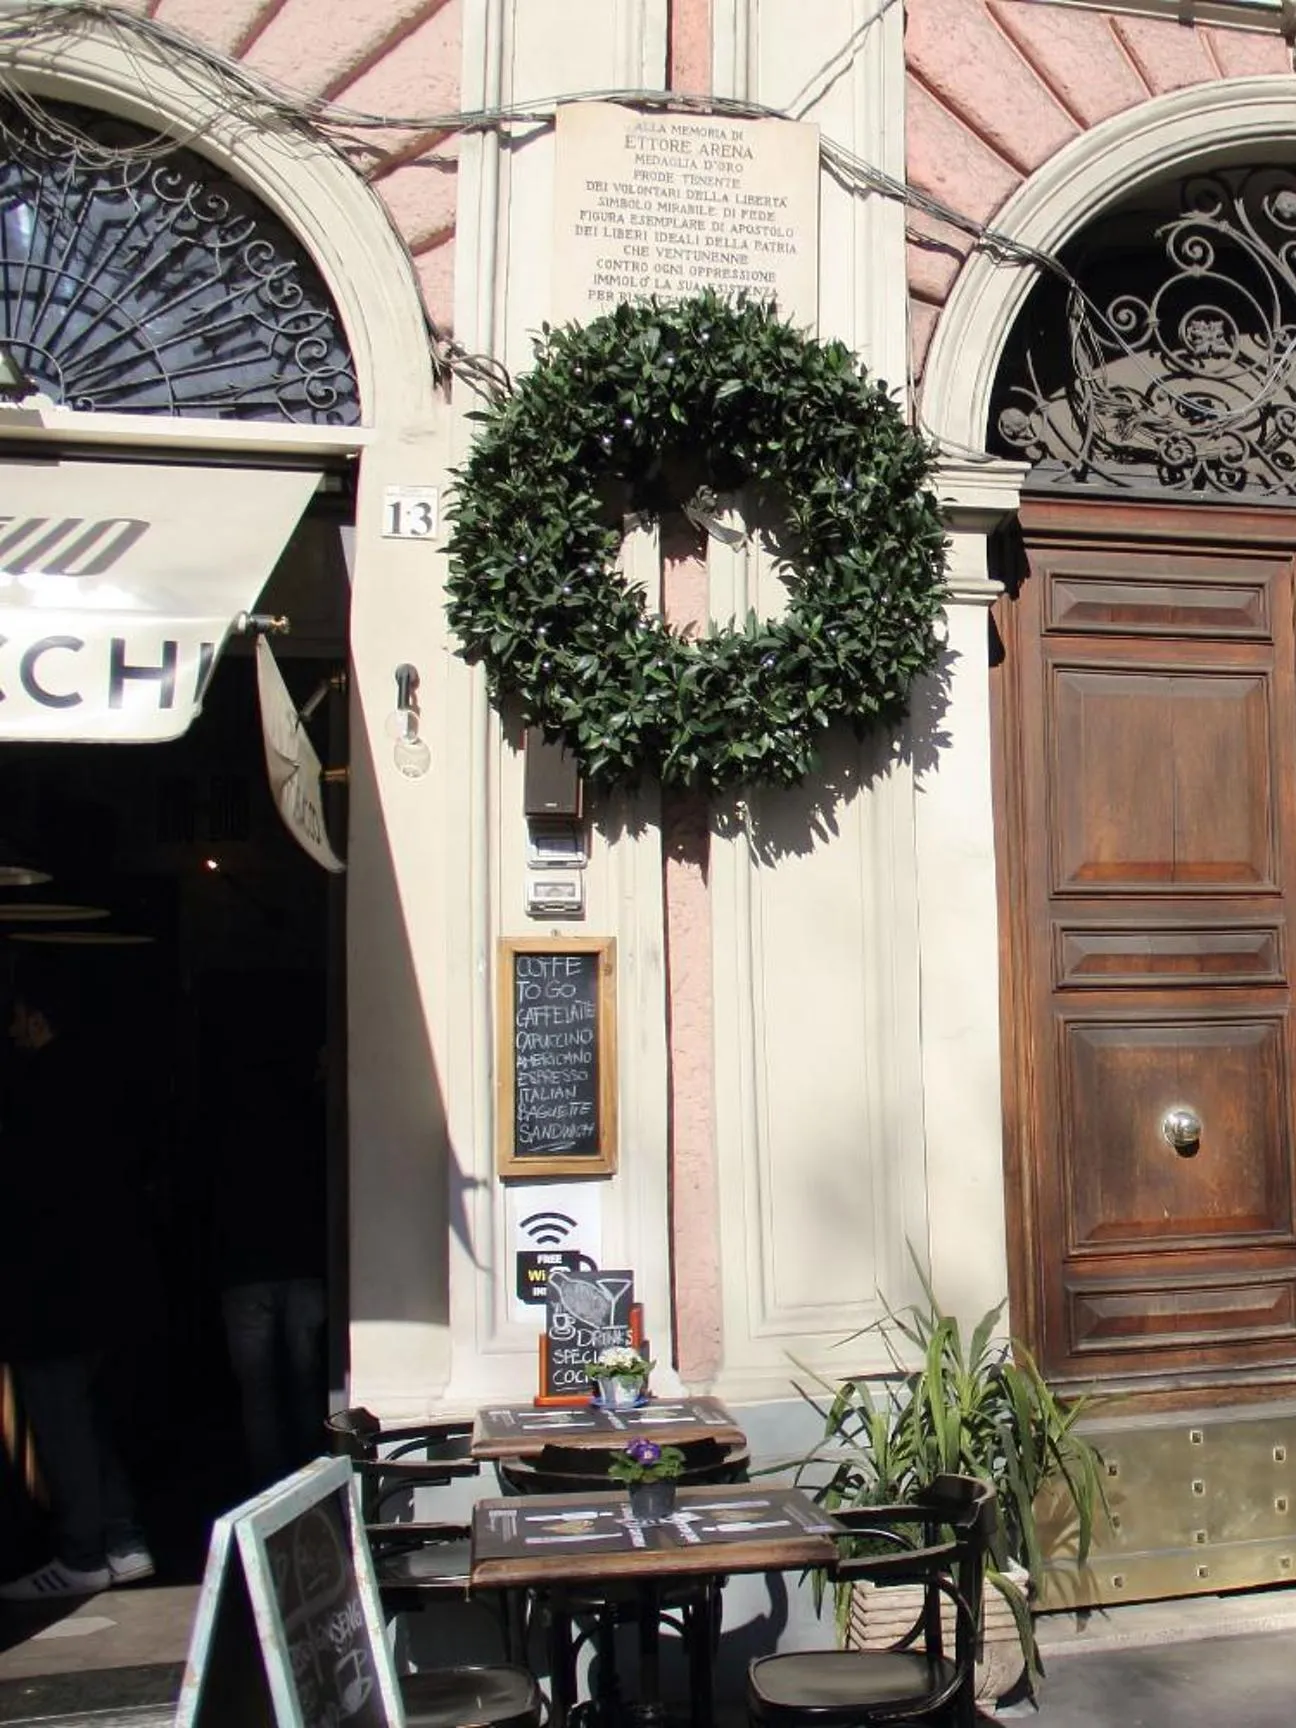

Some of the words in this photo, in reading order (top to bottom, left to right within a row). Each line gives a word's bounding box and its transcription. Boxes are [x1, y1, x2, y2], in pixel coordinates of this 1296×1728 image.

[635, 122, 666, 134] ALLA
[671, 125, 727, 140] MEMORIA
[732, 130, 743, 141] DI
[624, 134, 692, 153] ETTORE
[700, 143, 753, 160] ARENA
[635, 153, 698, 170] MEDAGLIA
[704, 159, 744, 173] D'ORO
[633, 168, 674, 183] PRODE
[683, 174, 741, 189] TENENTE
[585, 181, 607, 193] DEI
[613, 183, 681, 199] VOLONTARI
[686, 189, 729, 203] DELLA
[598, 197, 652, 210] SIMBOLO
[658, 202, 716, 217] MIRABILE
[724, 207, 735, 218] DI
[741, 209, 775, 222] FEDE
[580, 210, 624, 225] FIGURA
[630, 214, 706, 231] ESEMPLARE
[712, 221, 724, 232] DI
[731, 223, 794, 238] APOSTOLO
[575, 224, 598, 237] DEI
[603, 226, 647, 241] LIBERI
[655, 231, 699, 246] IDEALI
[705, 236, 748, 250] DELLA
[754, 240, 797, 255] PATRIA
[623, 245, 650, 257] CHE
[655, 246, 748, 265] VENTUNENNE
[596, 258, 648, 273] CONTRO
[654, 263, 684, 275] OGNI
[689, 266, 777, 283] OPPRESSIONE
[655, 278, 672, 290] LA
[677, 280, 700, 291] SUA
[588, 290, 614, 301] PER
[386, 500, 433, 536] 13
[516, 956, 582, 979] COFFE
[516, 981, 541, 1003] TO
[545, 979, 577, 998] GO
[517, 1048, 592, 1069] AMERICANO
[517, 1069, 589, 1087] ESPRESSO
[519, 1086, 577, 1104] ITALIAN
[518, 1101, 593, 1122] BAGUETTE
[519, 1122, 595, 1144] SANDWICH
[536, 1253, 563, 1264] FREE
[552, 1348, 601, 1364] SPECI
